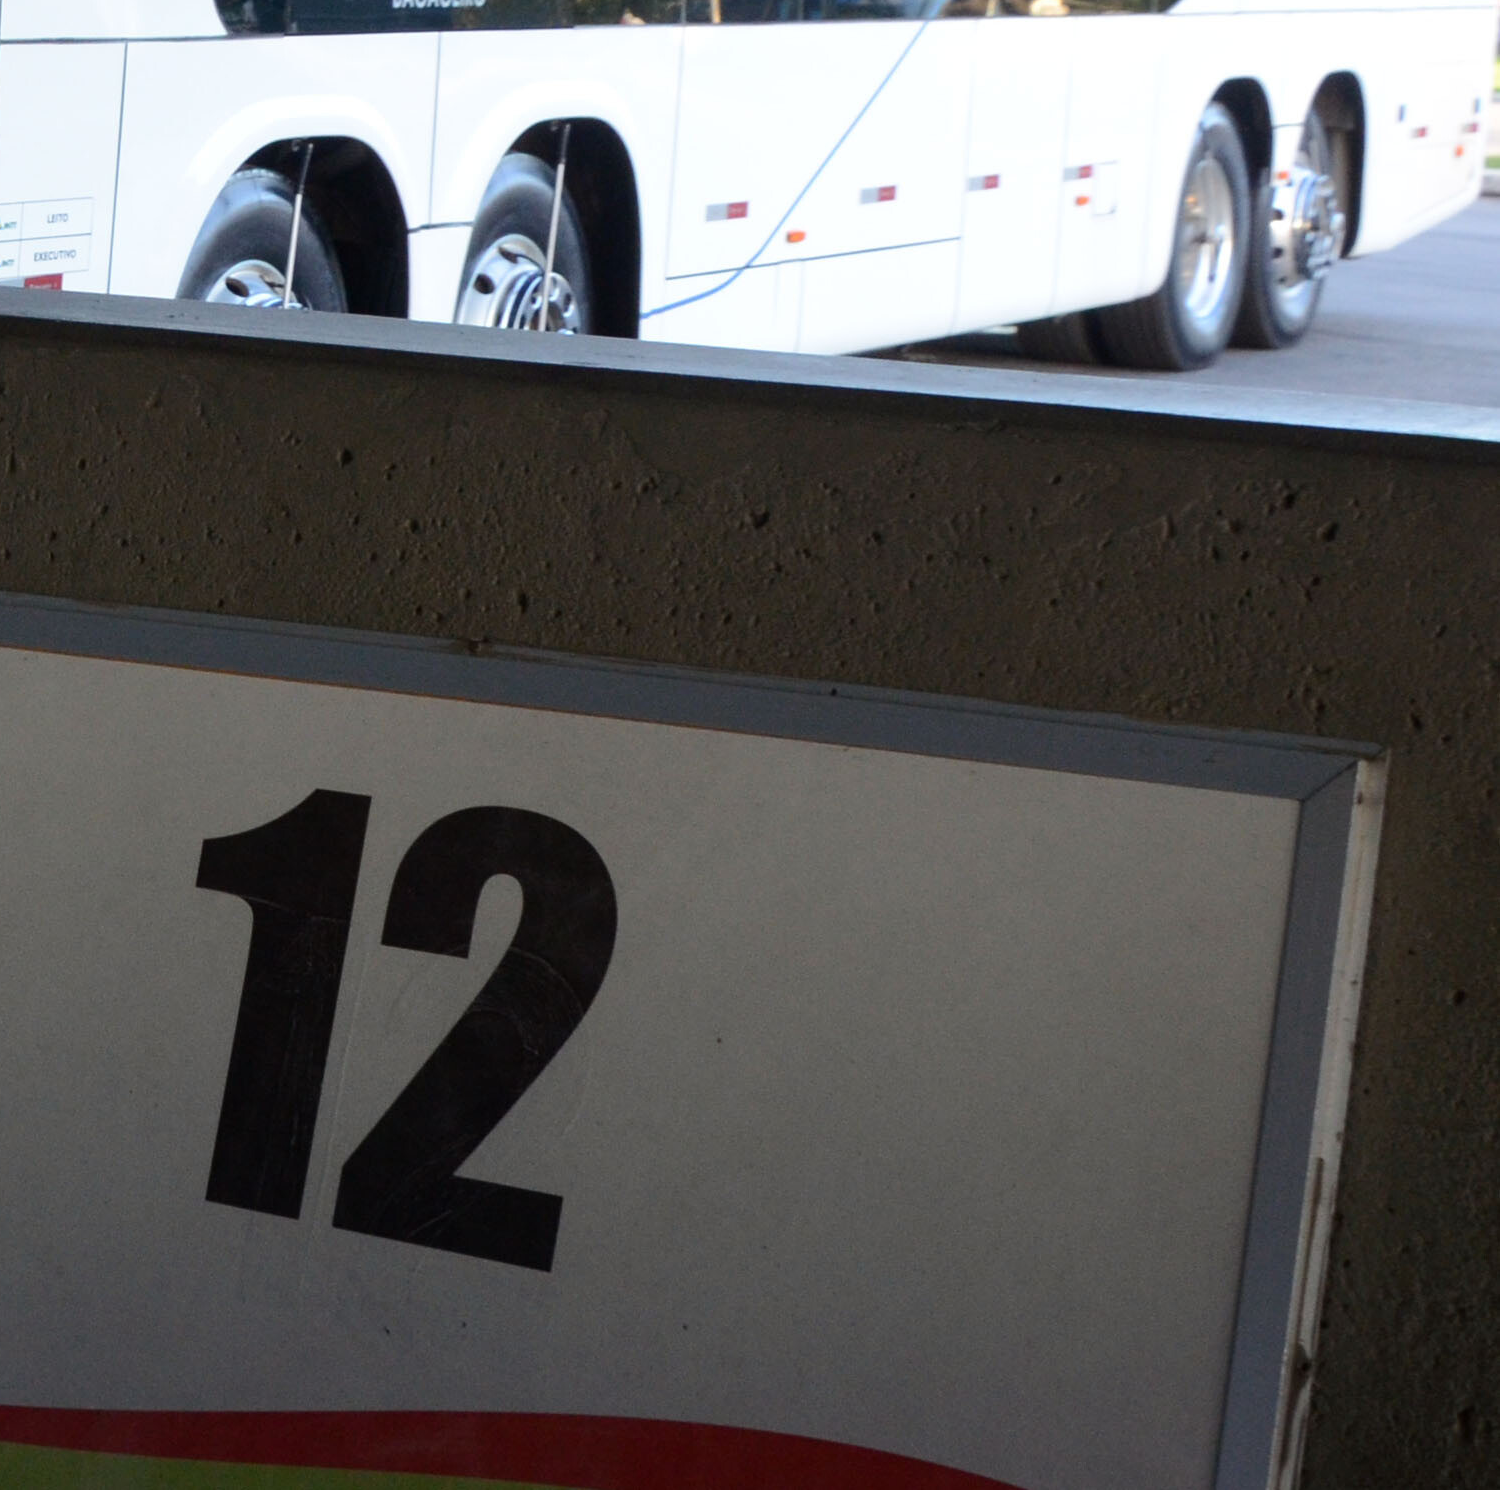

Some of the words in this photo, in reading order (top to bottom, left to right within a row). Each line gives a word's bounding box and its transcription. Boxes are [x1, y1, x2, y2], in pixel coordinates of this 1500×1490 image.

[46, 212, 70, 225] LEITO
[33, 249, 78, 263] EXECUTIVO
[195, 786, 621, 1275] 12
